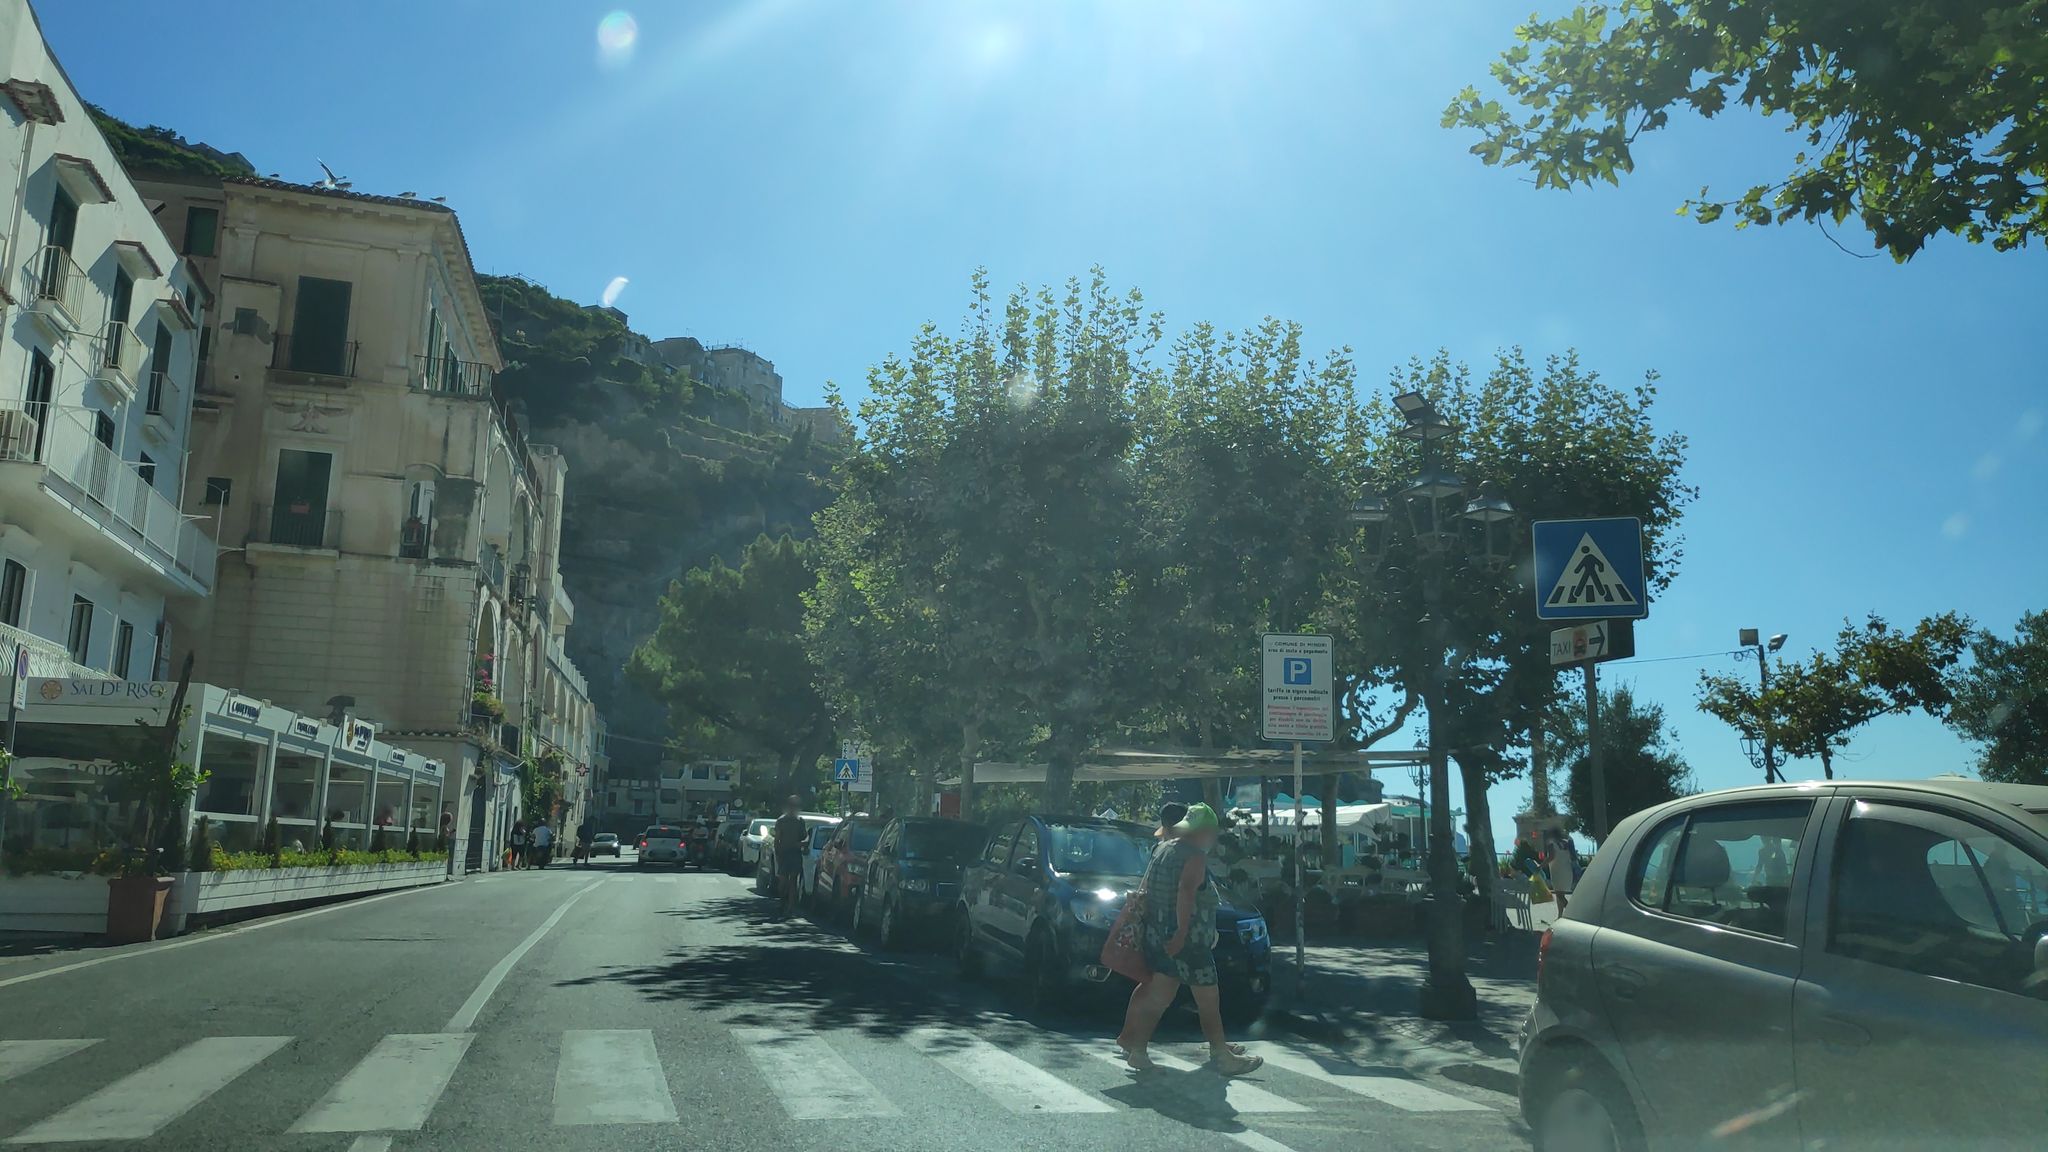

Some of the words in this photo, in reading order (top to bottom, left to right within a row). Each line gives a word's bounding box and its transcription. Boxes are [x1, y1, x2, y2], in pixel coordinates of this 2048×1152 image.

[1552, 640, 1571, 657] TAXI
[1291, 661, 1307, 682] P
[71, 681, 95, 696] SAL
[100, 681, 121, 696] DE
[126, 682, 164, 699] RISO
